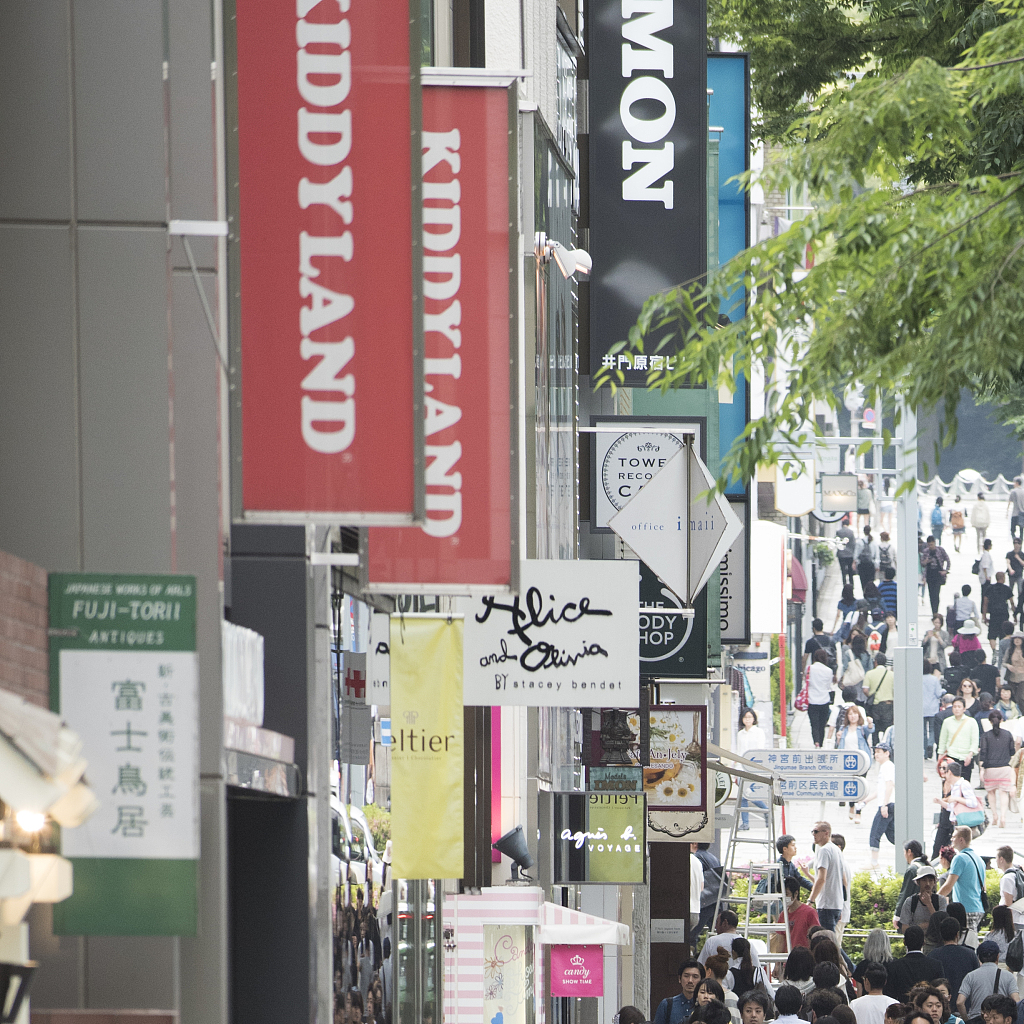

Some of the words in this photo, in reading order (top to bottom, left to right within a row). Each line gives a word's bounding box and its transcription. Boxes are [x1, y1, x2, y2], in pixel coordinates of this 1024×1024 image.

[422, 128, 463, 538] KIDDYLAND
[602, 354, 686, 371] 井門原宿ビ
[618, 458, 667, 468] TOWE
[618, 472, 653, 480] RECO
[631, 522, 664, 531] office
[719, 548, 733, 632] missimo
[72, 600, 181, 621] FUJI-TORII
[475, 586, 613, 646] Alice
[639, 615, 677, 630] ODY
[88, 629, 165, 646] ANTIQUES
[639, 631, 674, 645] HOP
[479, 638, 518, 668] and
[519, 640, 609, 672] Olivia
[736, 663, 766, 673] hicago
[494, 673, 508, 690] BY
[513, 679, 562, 691] stacey
[571, 680, 622, 690] bendet
[110, 679, 149, 838] 富士鳥居
[593, 779, 637, 791] IMON
[780, 781, 839, 790] 宮前区民会館
[588, 844, 641, 853] VOYAGE
[564, 965, 591, 979] candy
